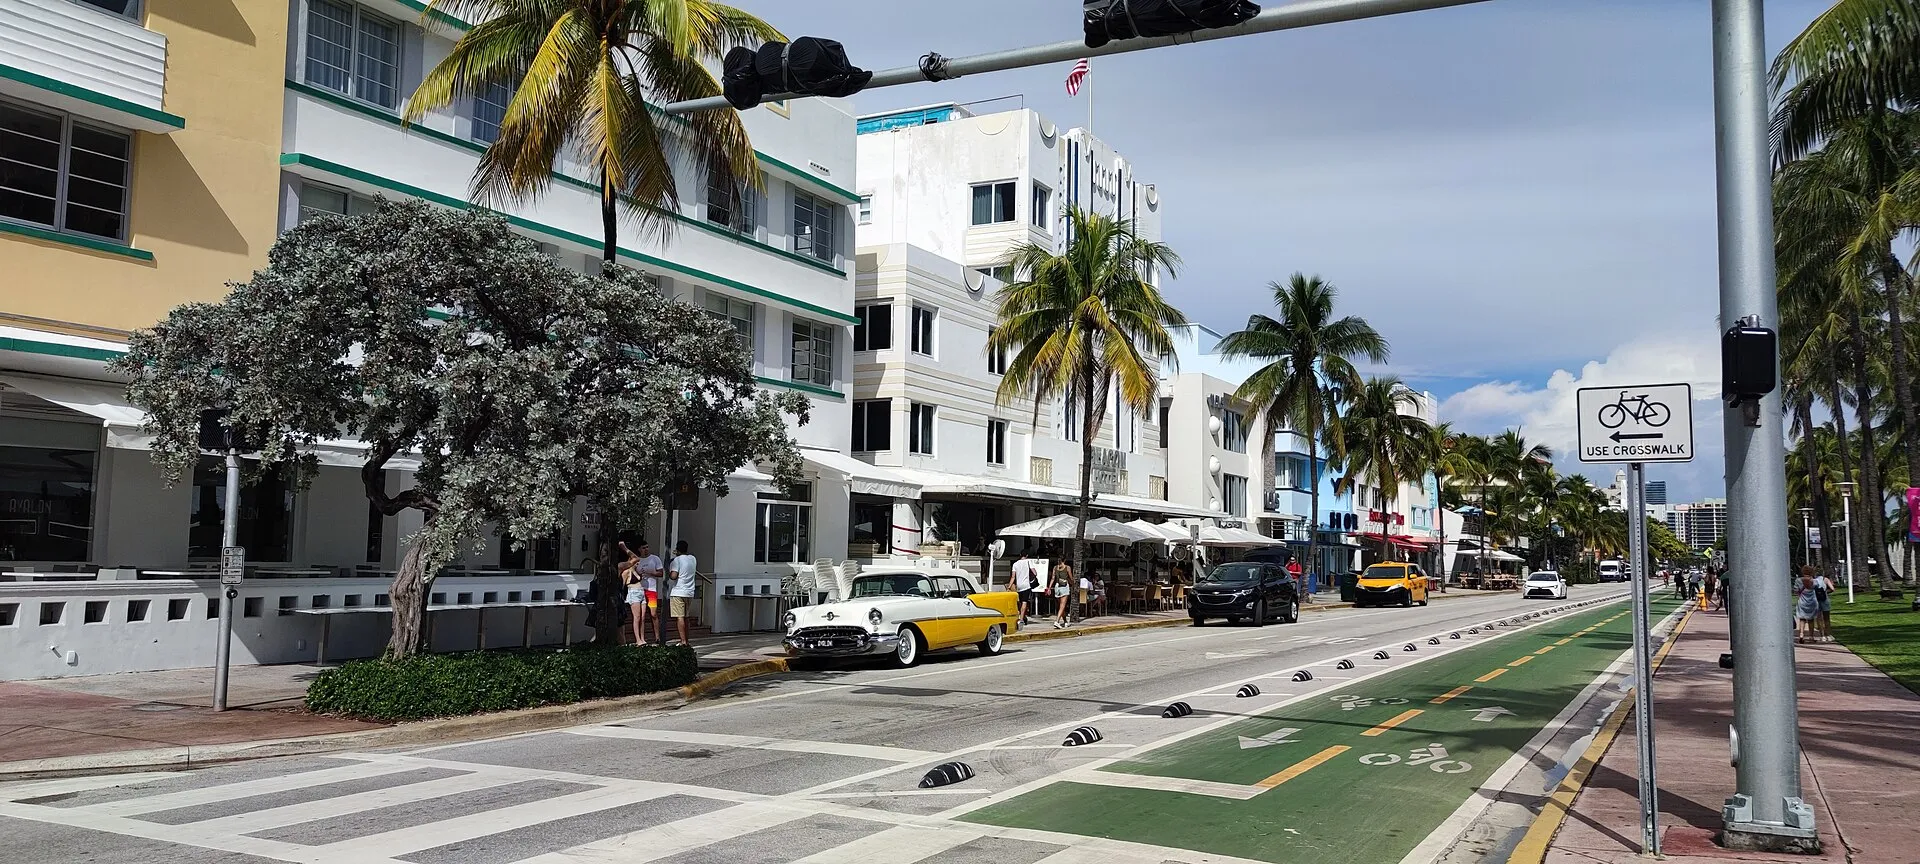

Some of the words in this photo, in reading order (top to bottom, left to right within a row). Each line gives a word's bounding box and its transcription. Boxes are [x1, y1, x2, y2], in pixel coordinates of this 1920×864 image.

[1586, 446, 1609, 456] USE
[1613, 444, 1685, 456] CROSSWALK
[9, 498, 52, 514] AVALON
